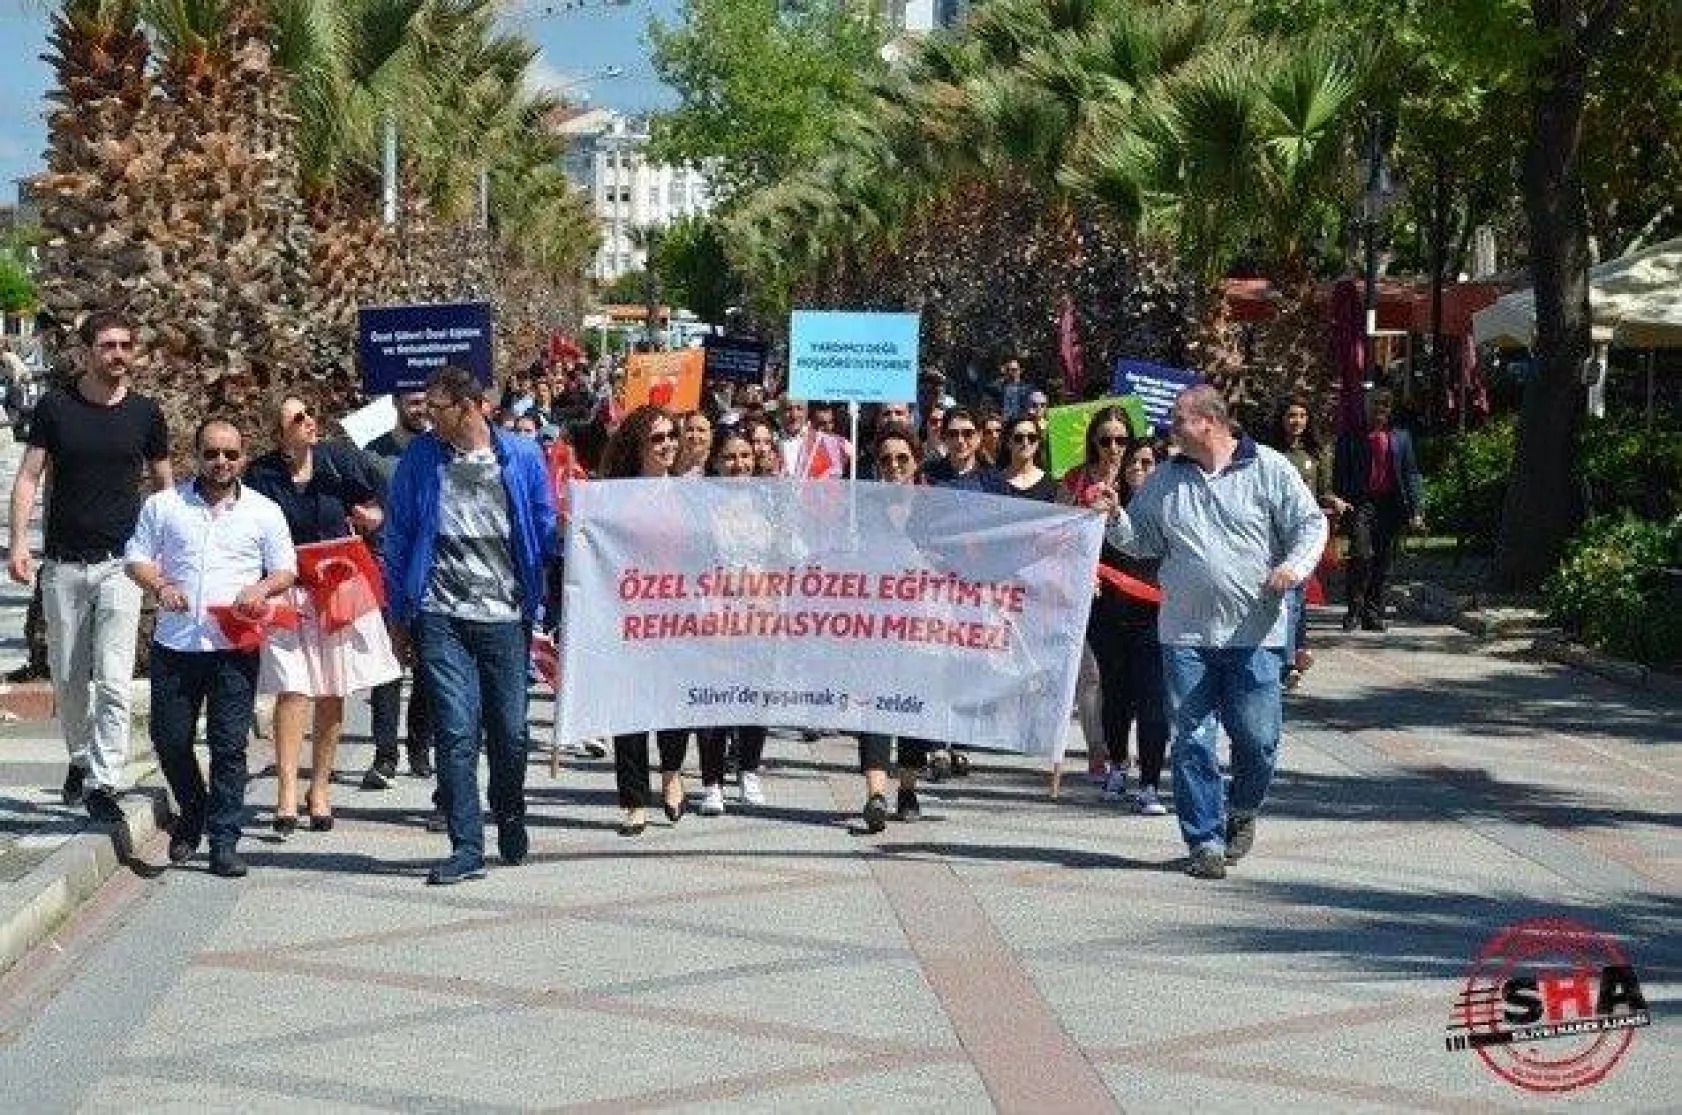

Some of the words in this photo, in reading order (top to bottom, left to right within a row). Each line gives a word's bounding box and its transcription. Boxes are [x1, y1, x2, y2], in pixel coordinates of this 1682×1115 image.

[620, 569, 686, 599] ÖZEL
[694, 567, 795, 598] SİLİVRİ
[802, 565, 869, 597] ÖZEL
[879, 569, 981, 606] EĞİTİM
[991, 582, 1026, 612] VE
[623, 604, 873, 639] REHABİLİTASYON
[882, 614, 1012, 650] MERKEZİ
